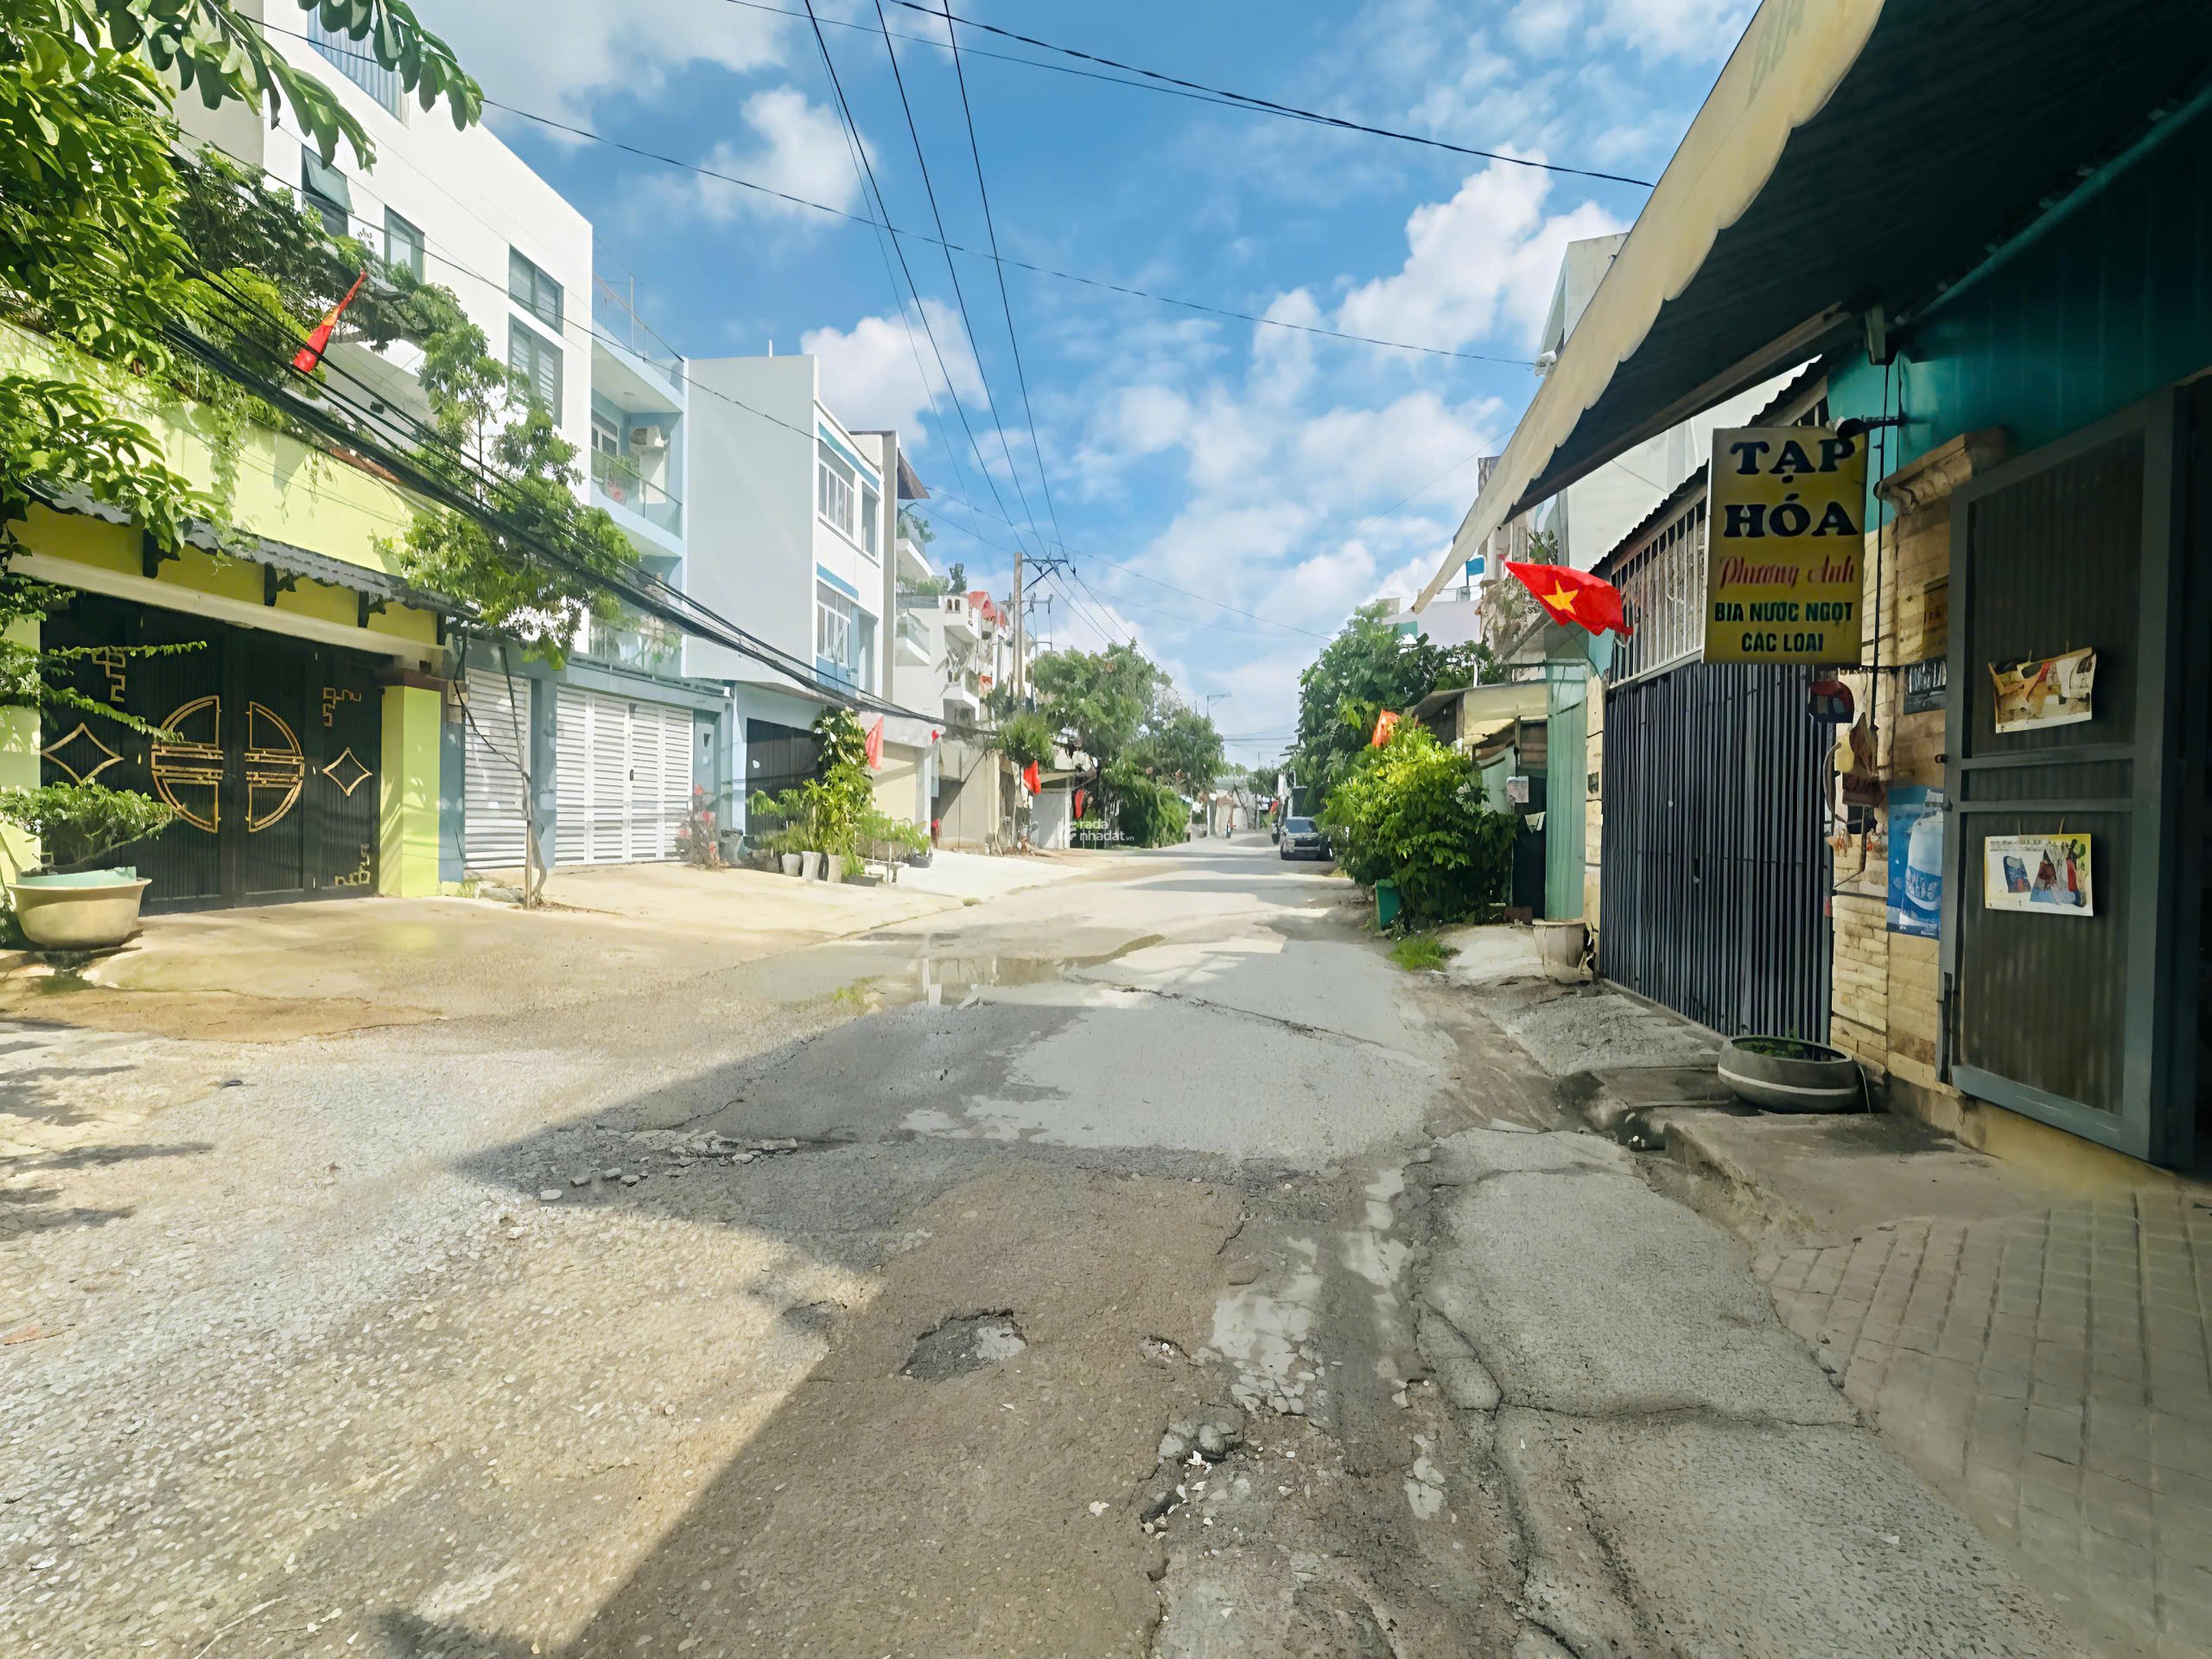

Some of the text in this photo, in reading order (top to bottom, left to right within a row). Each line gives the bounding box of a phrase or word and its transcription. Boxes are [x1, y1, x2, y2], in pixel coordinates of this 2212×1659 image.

[1730, 438, 1855, 484] TẠP
[1723, 493, 1858, 537] HÓA
[1714, 602, 1744, 622] BIA
[1806, 602, 1853, 626] NGỌT
